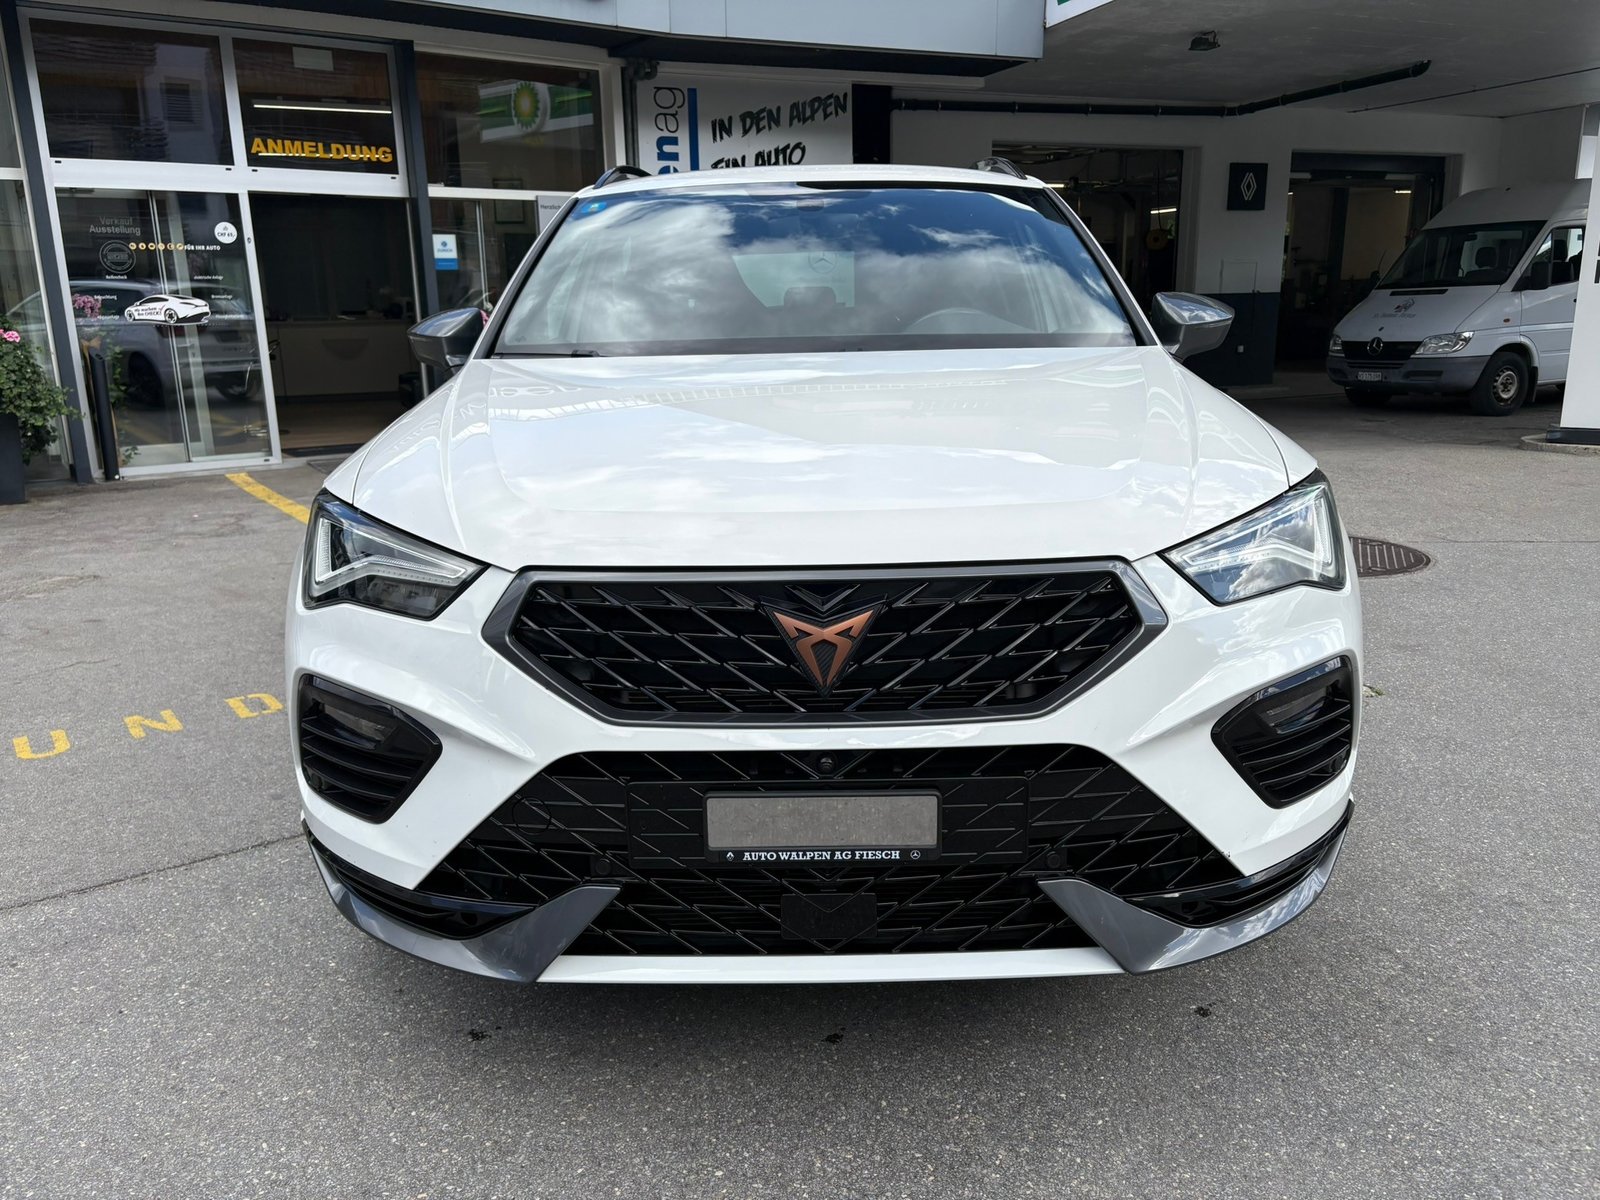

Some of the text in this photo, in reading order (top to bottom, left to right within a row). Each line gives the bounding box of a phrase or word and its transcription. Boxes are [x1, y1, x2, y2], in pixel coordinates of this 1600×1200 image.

[711, 92, 848, 143] IN DEN ALPEN
[251, 137, 393, 163] ANMELDUNG
[755, 142, 806, 167] AUTO
[89, 224, 141, 236] Ausstellung
[742, 850, 900, 862] AUTO WALPEN AG FIESCH
